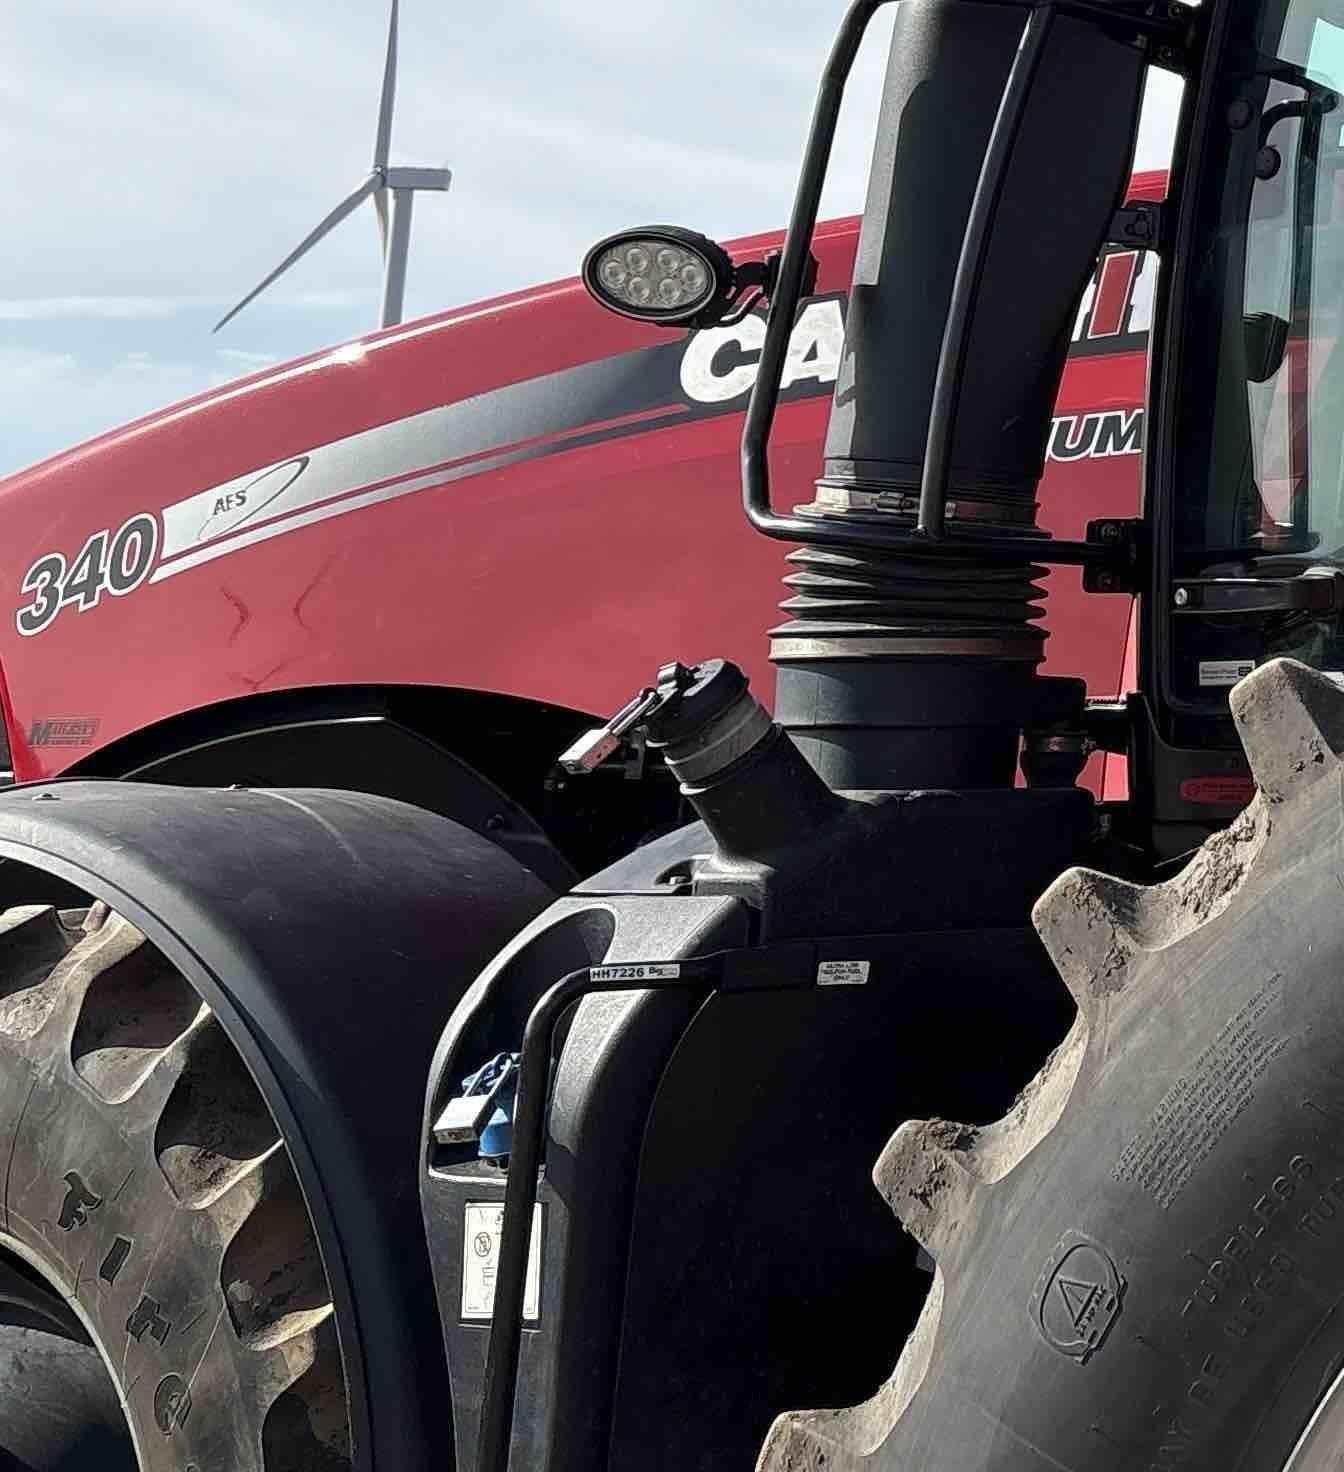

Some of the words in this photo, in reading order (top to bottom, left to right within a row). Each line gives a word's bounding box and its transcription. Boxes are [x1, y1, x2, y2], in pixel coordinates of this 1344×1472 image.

[680, 300, 847, 402] CA
[1046, 410, 1144, 462] UM
[213, 490, 247, 515] AFS
[16, 513, 157, 636] 340
